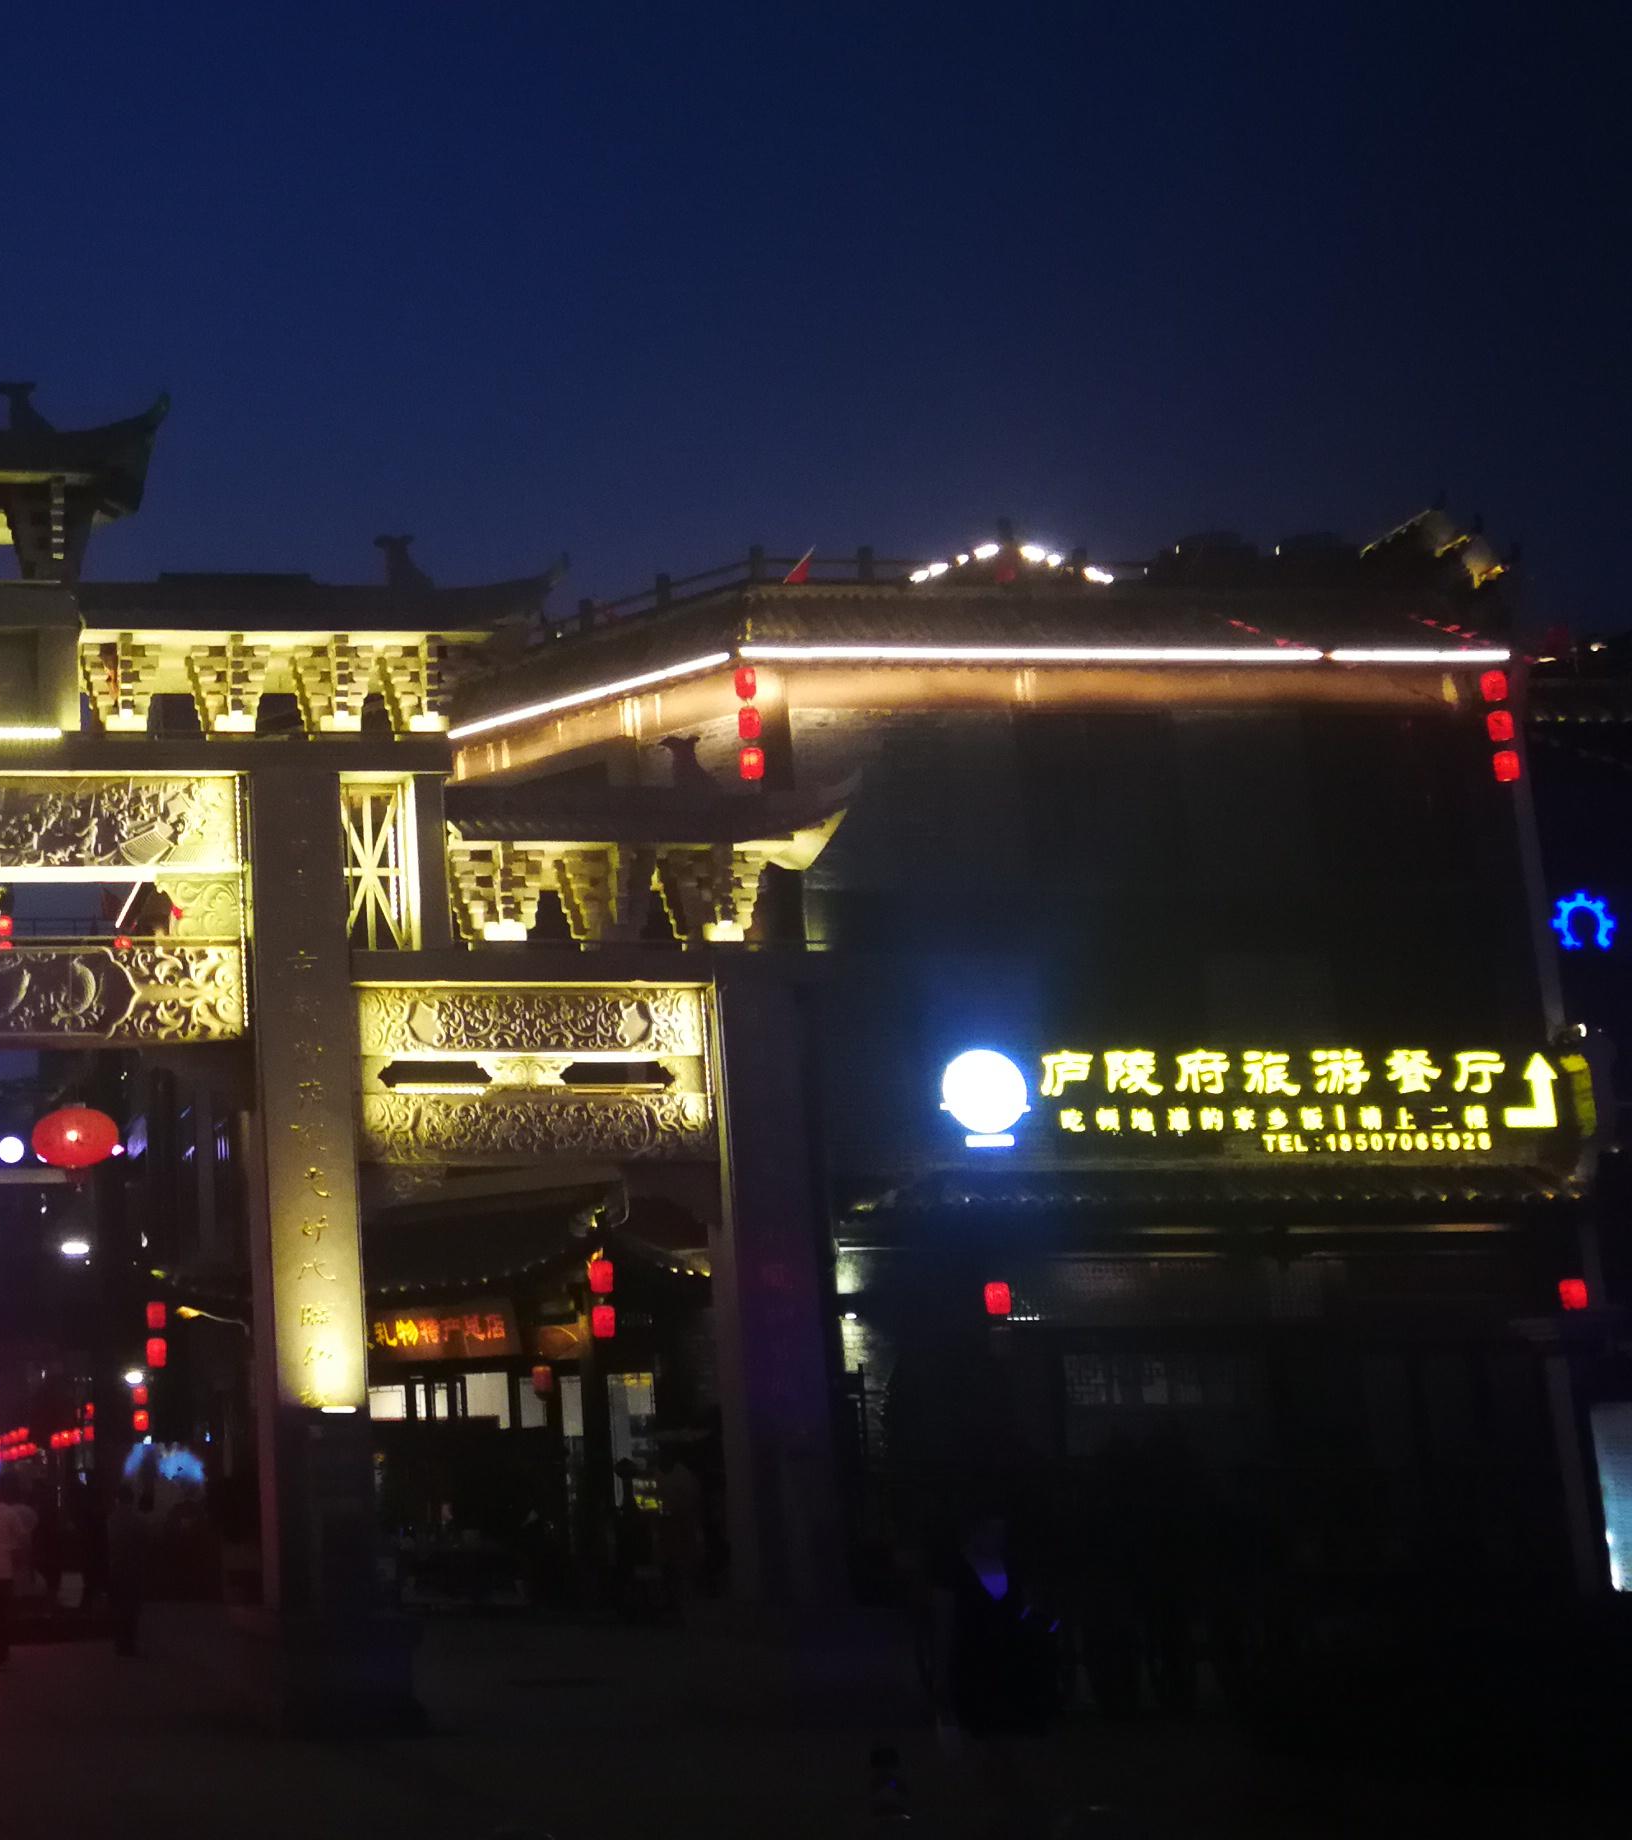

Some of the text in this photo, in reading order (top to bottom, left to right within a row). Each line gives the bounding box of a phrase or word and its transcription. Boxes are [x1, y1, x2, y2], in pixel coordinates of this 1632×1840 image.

[1039, 1048, 1507, 1098] 庐陵府旅游餐厅
